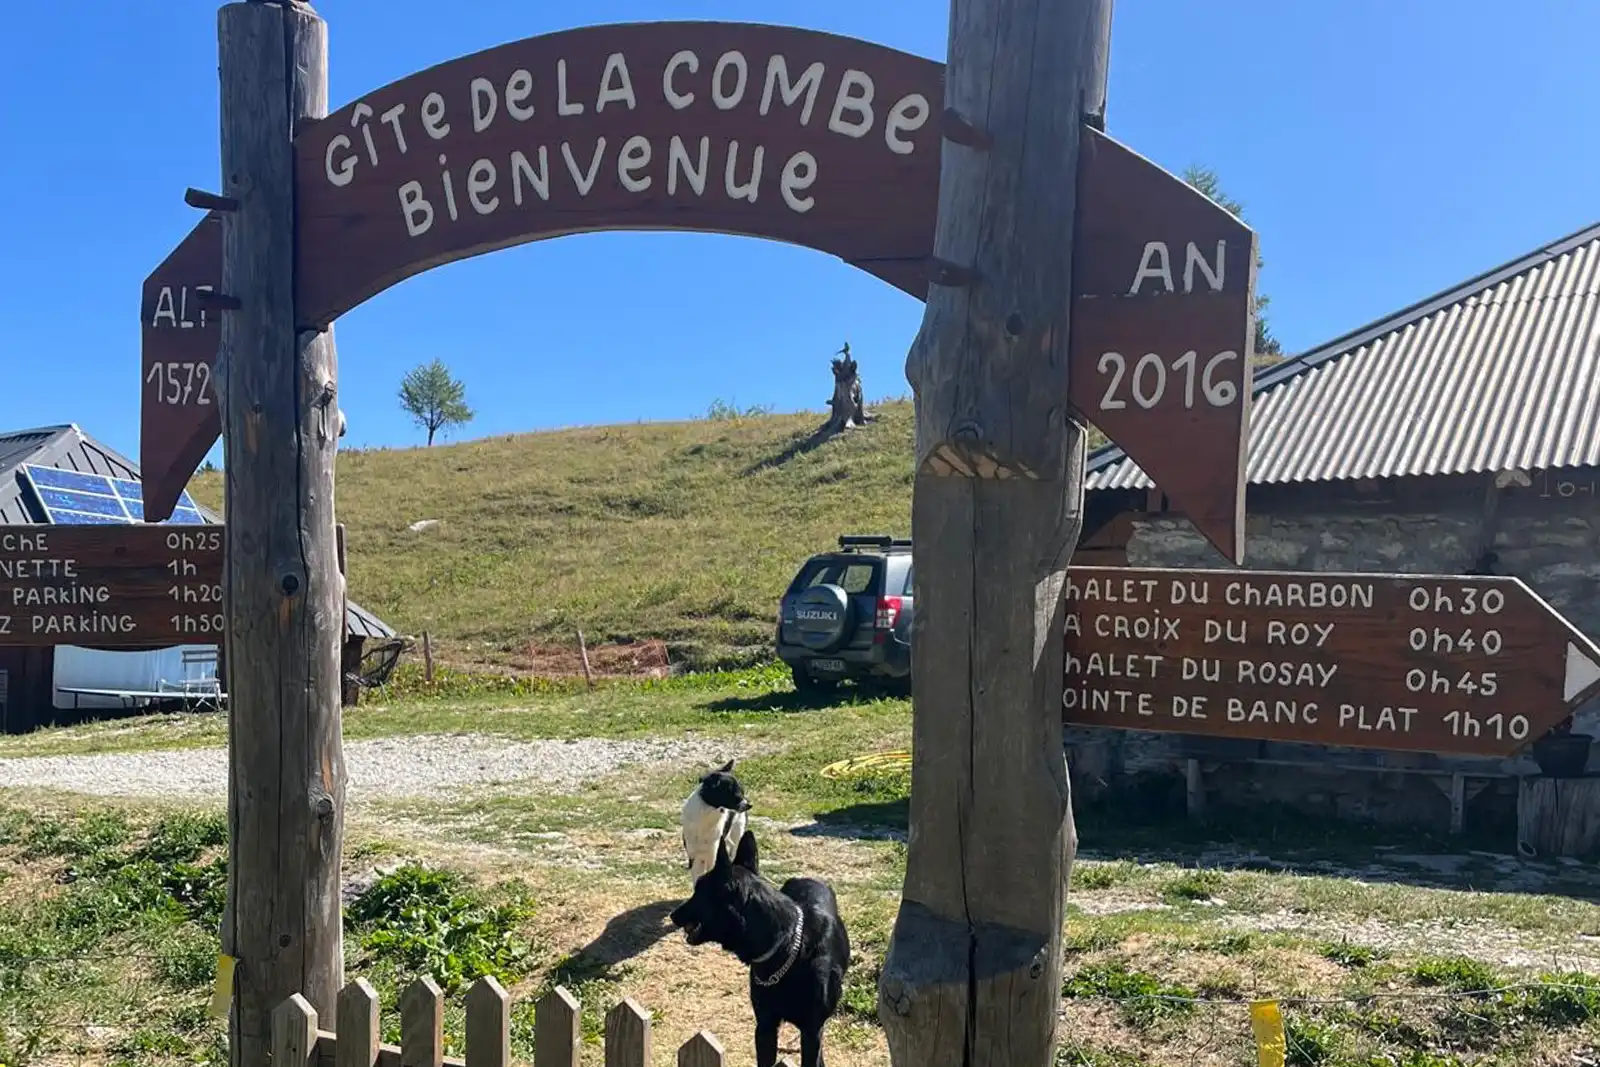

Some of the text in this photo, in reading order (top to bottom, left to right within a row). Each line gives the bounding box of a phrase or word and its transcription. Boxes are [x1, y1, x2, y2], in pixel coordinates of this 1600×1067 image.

[558, 53, 635, 115] LA
[1130, 240, 1225, 293] AN
[153, 286, 212, 328] ALT
[147, 362, 210, 405] 1572
[1098, 351, 1237, 409] 2016
[3, 532, 219, 551] ChE 0h25
[0, 559, 196, 578] NETTE 1h
[169, 584, 222, 602] 1h20
[1066, 578, 1158, 602] hALET
[1171, 581, 1208, 604] DU
[1410, 587, 1504, 614] 0h30
[0, 616, 11, 633] Z
[171, 614, 224, 632] 1h50
[796, 610, 837, 620] SUZUKI
[1064, 615, 1080, 637] A
[1205, 620, 1246, 643] DU
[1268, 621, 1334, 646] ROY
[1410, 628, 1501, 654] 0h40
[1066, 653, 1496, 695] hALET DU ROSAY 0h45
[1063, 680, 1528, 739] OiNTE DE BANC PLAT 1h10
